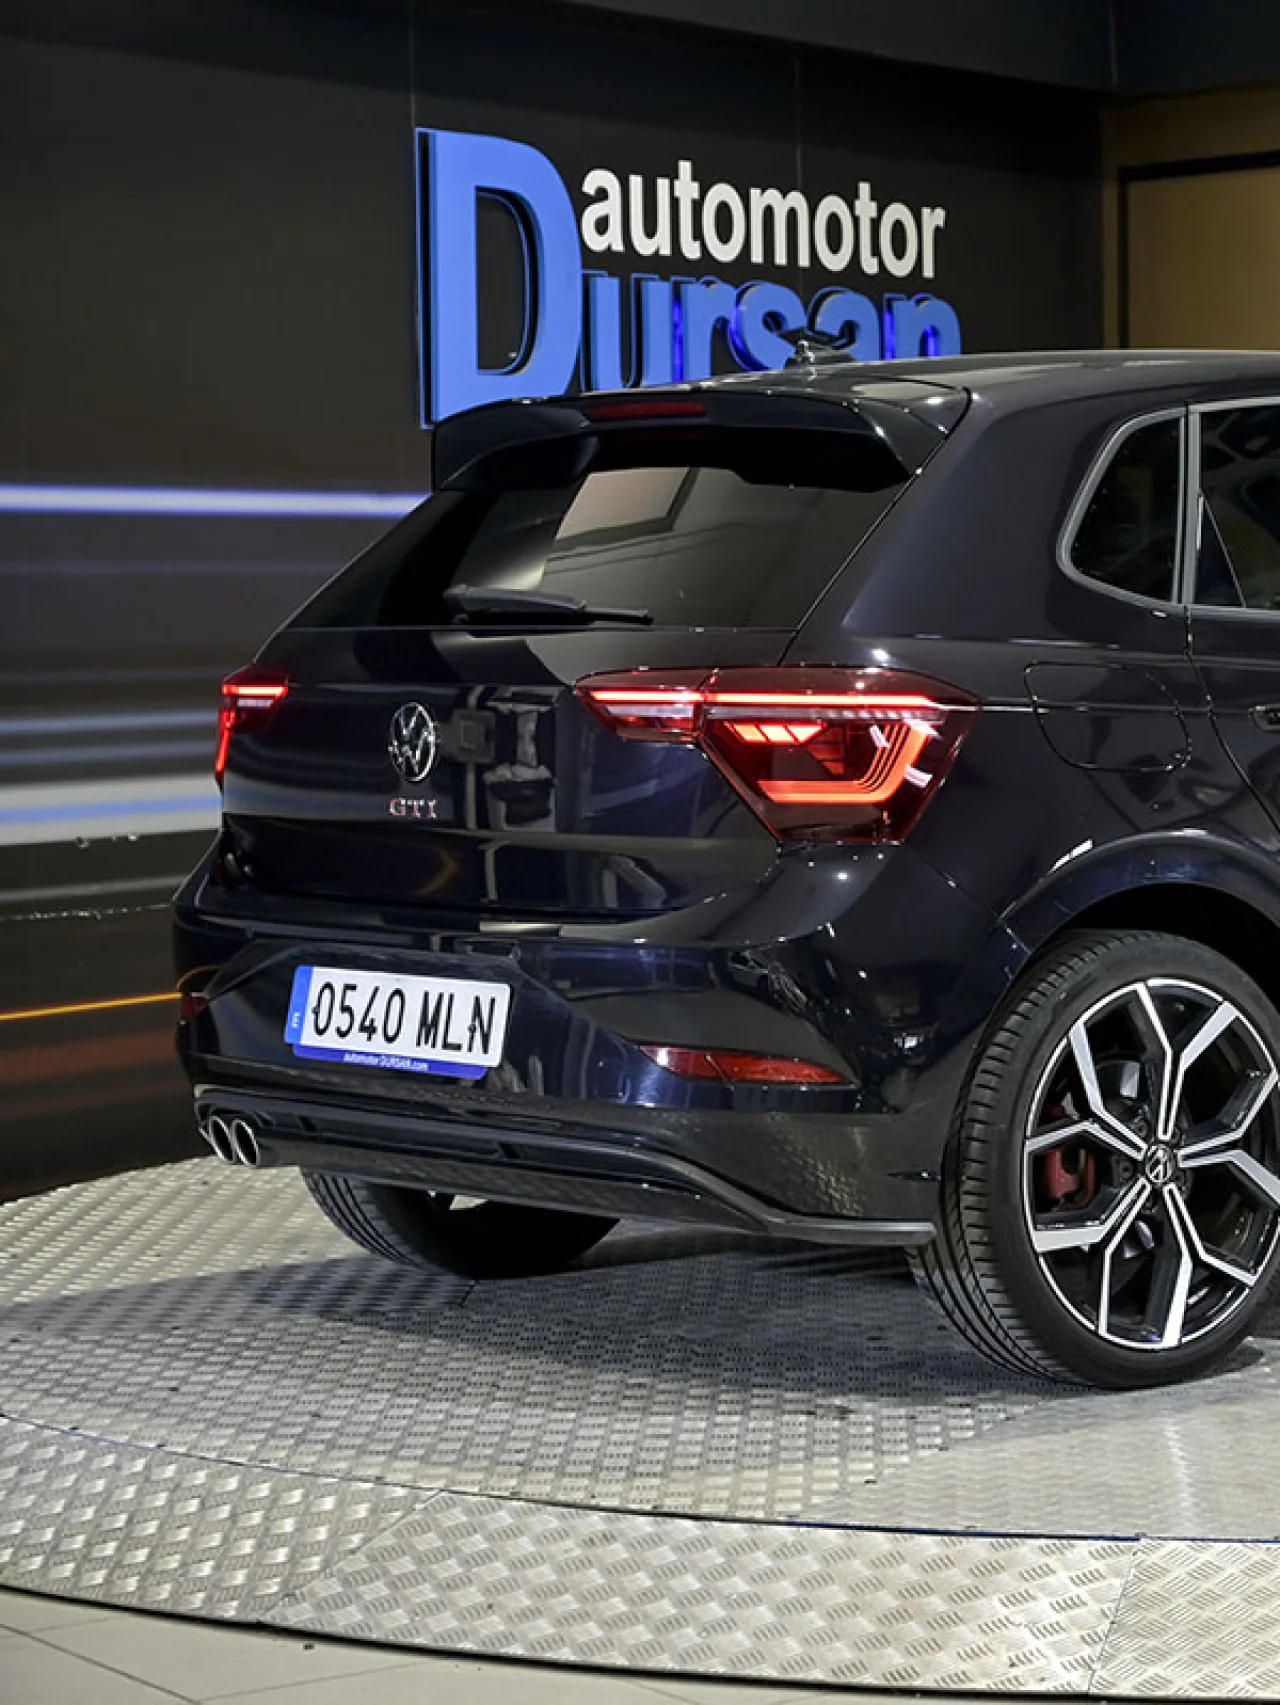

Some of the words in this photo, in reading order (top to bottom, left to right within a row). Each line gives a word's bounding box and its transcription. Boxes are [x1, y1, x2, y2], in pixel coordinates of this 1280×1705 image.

[581, 160, 946, 278] automotor
[415, 128, 961, 428] Dursan
[389, 798, 437, 818] GTI
[312, 982, 405, 1044] 0540
[415, 990, 496, 1054] MLN
